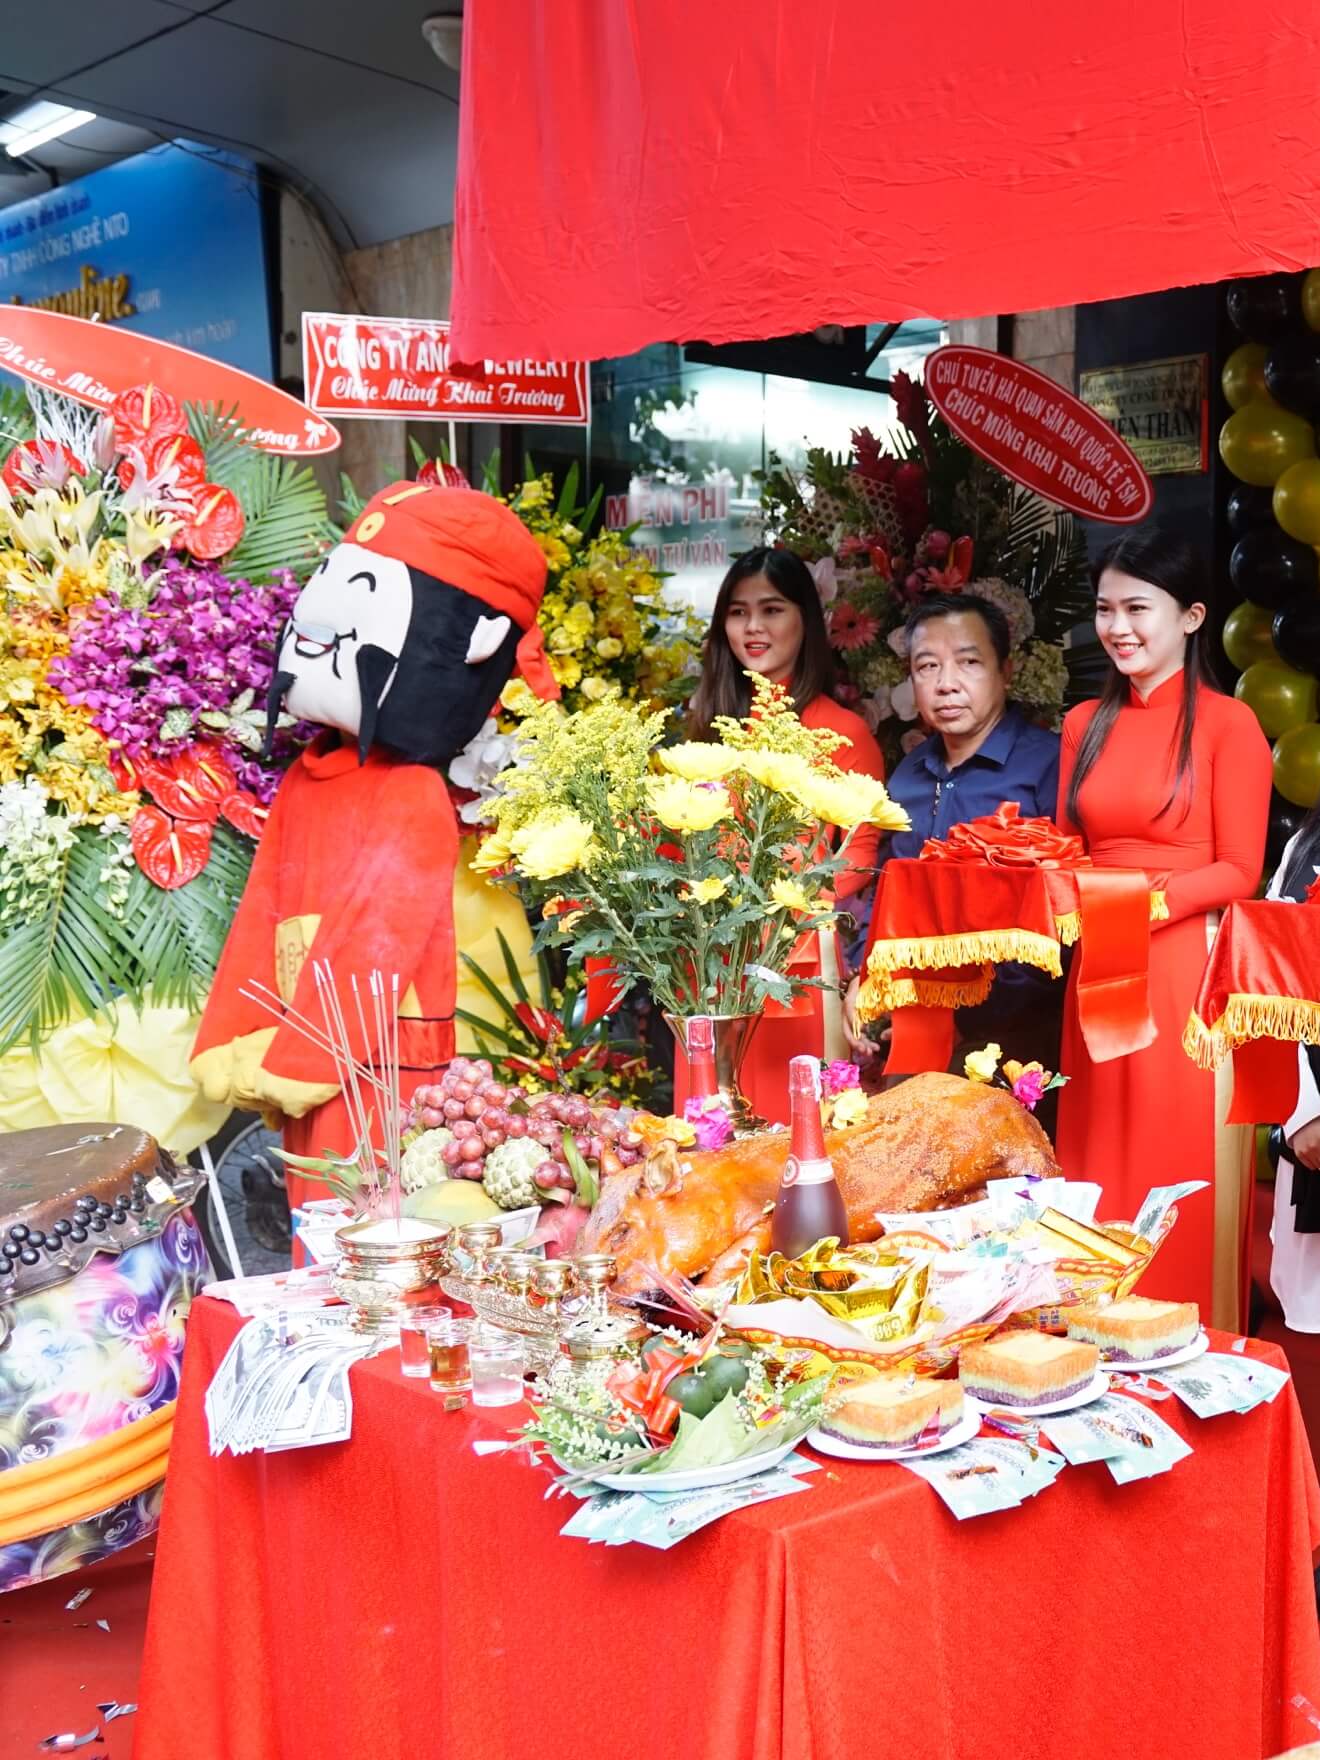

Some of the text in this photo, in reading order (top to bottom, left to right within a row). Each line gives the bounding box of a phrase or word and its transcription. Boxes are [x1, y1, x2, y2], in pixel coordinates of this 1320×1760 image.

[384, 337, 411, 371] TY
[57, 371, 118, 404] Mừn
[330, 375, 566, 413] Chúc Mừng Khai Trương
[944, 387, 986, 427] CHÚC
[981, 409, 1026, 454] MỪNG
[1022, 437, 1059, 476] KHAI
[1060, 418, 1088, 449] BAY
[1080, 435, 1115, 472] QUỐC
[1103, 460, 1132, 486] TẾ
[1114, 476, 1141, 508] TSN
